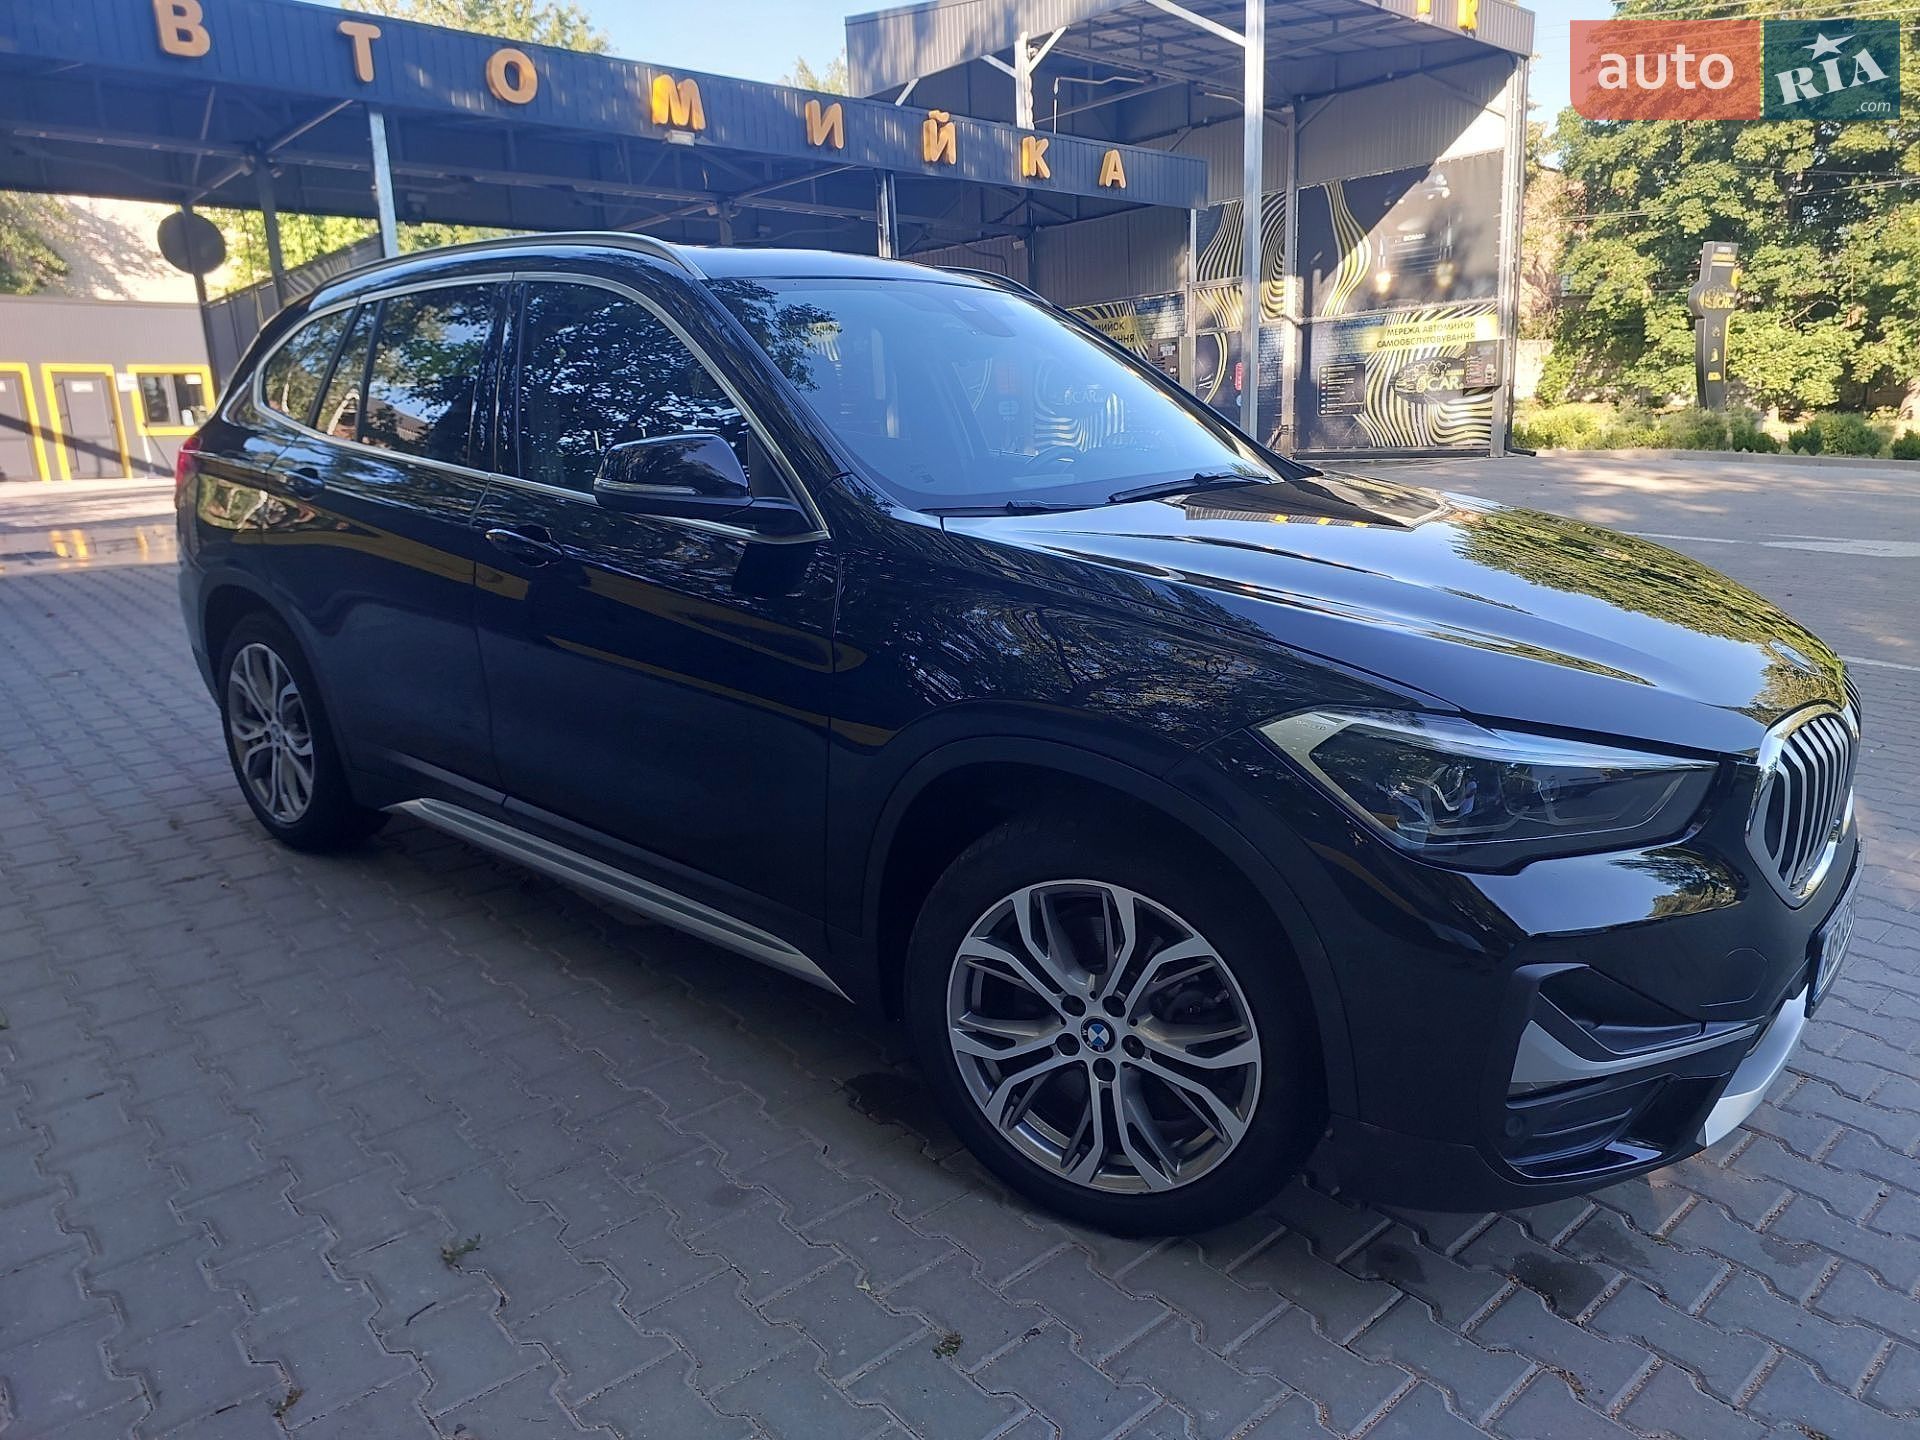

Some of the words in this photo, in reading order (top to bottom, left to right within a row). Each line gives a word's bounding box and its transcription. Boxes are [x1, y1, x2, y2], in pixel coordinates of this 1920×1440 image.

[1386, 327, 1420, 336] МЕРЕЖА
[1422, 320, 1475, 333] АВТОМИЙОК
[1376, 332, 1476, 348] САМООБСЛУГОВУВАННЯ
